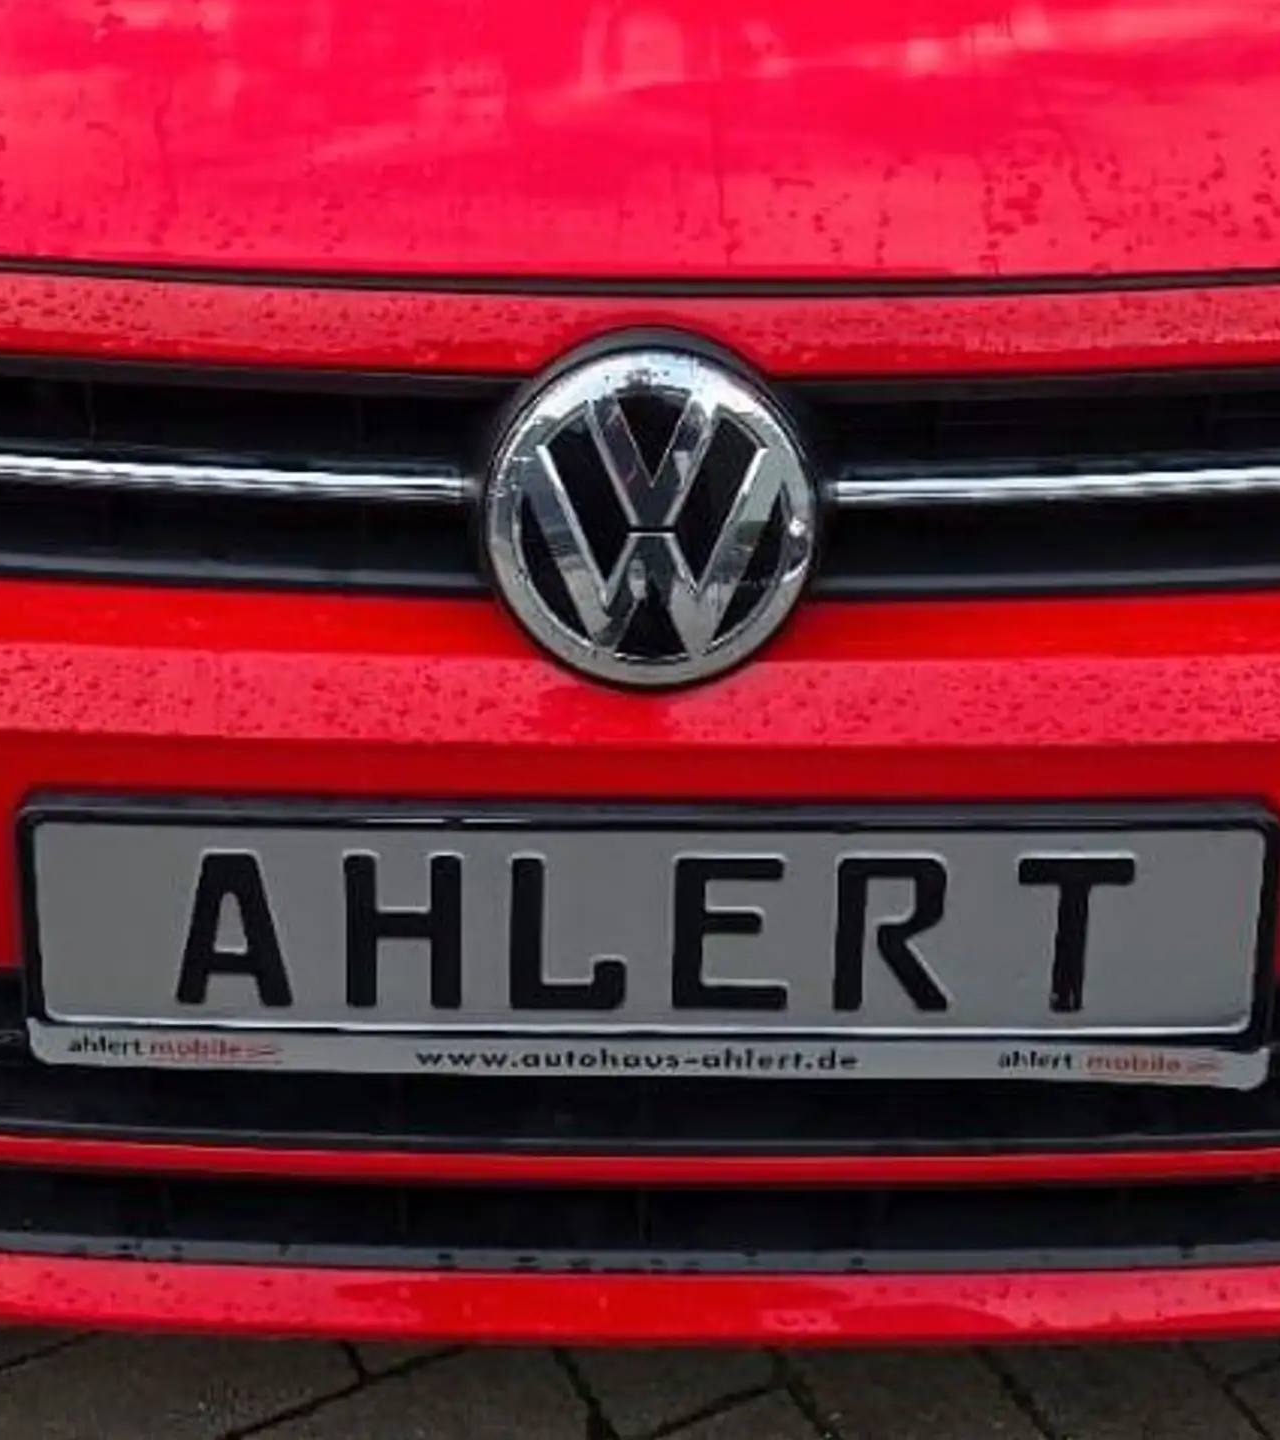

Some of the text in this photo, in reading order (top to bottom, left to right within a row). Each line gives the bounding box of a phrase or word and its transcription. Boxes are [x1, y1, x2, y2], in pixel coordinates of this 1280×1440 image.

[175, 851, 1137, 1013] AHLERT
[67, 1035, 243, 1060] ahlert mobile
[415, 1048, 860, 1072] www.autohaus-ahlert.de
[997, 1051, 1182, 1074] ahlert mobile
